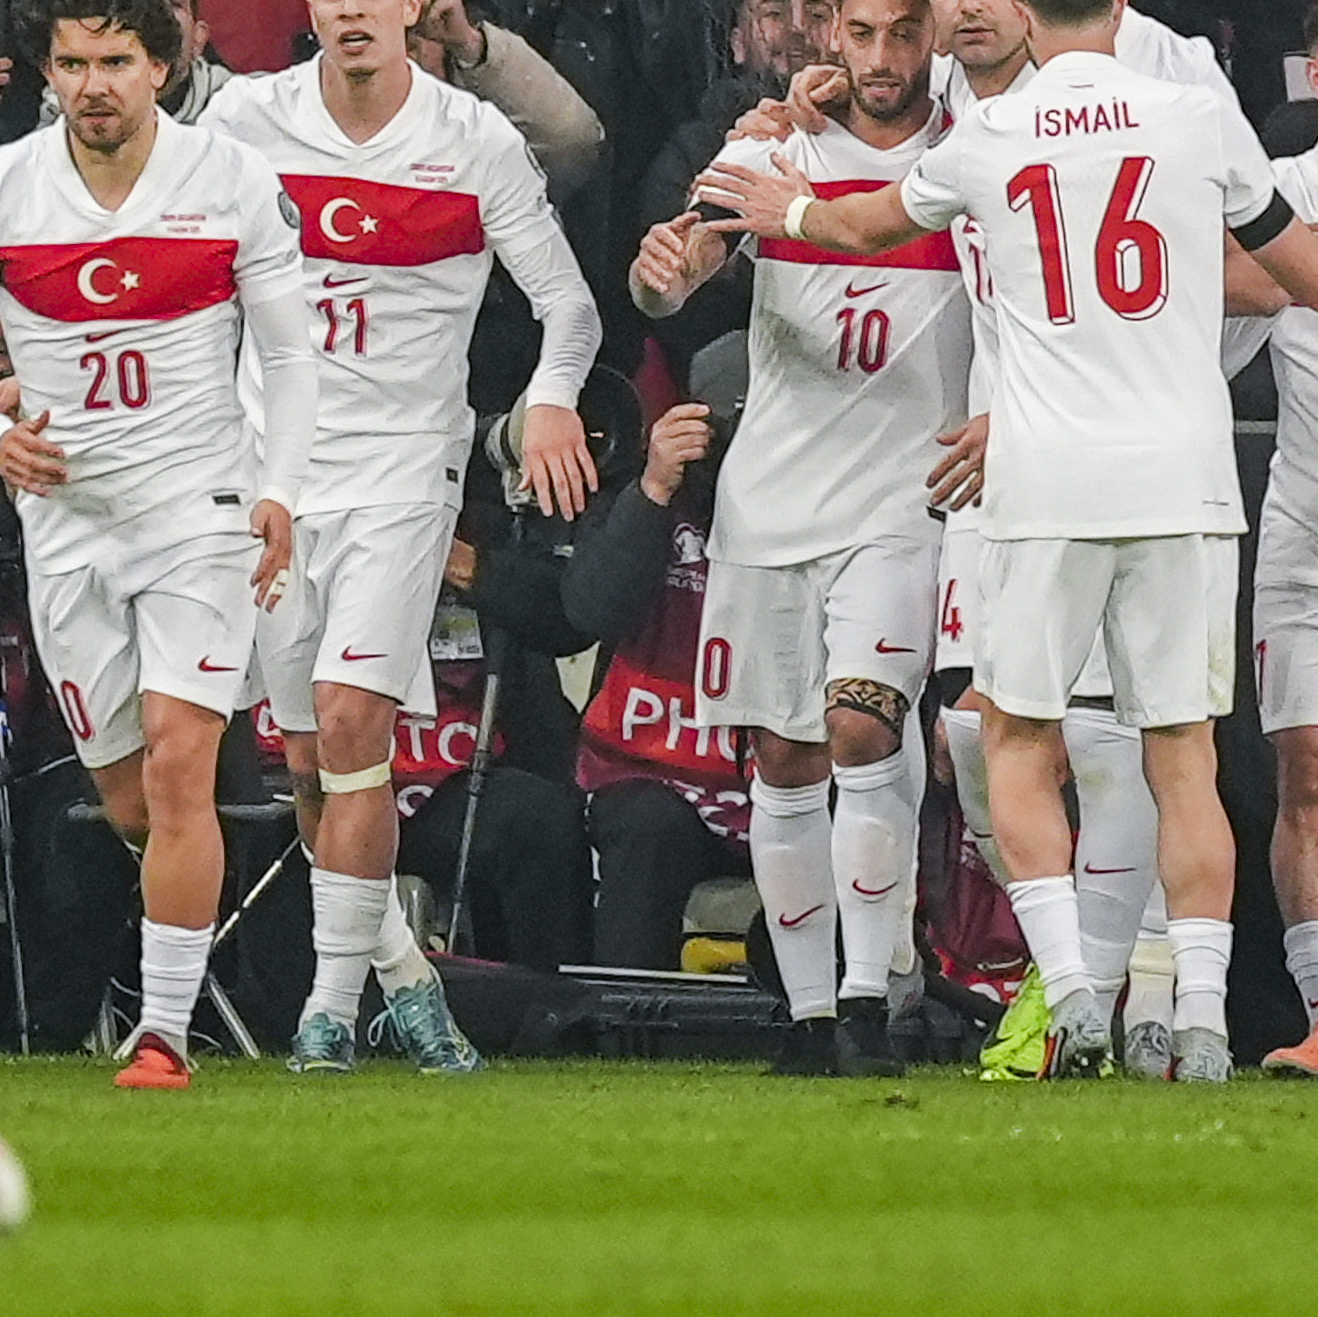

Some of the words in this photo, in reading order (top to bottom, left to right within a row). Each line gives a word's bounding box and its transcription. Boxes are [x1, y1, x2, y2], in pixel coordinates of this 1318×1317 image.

[1034, 96, 1140, 138] İSMAİL
[1007, 156, 1170, 326] 16
[316, 297, 369, 357] 11
[836, 307, 892, 374] 10
[79, 349, 152, 412] 20
